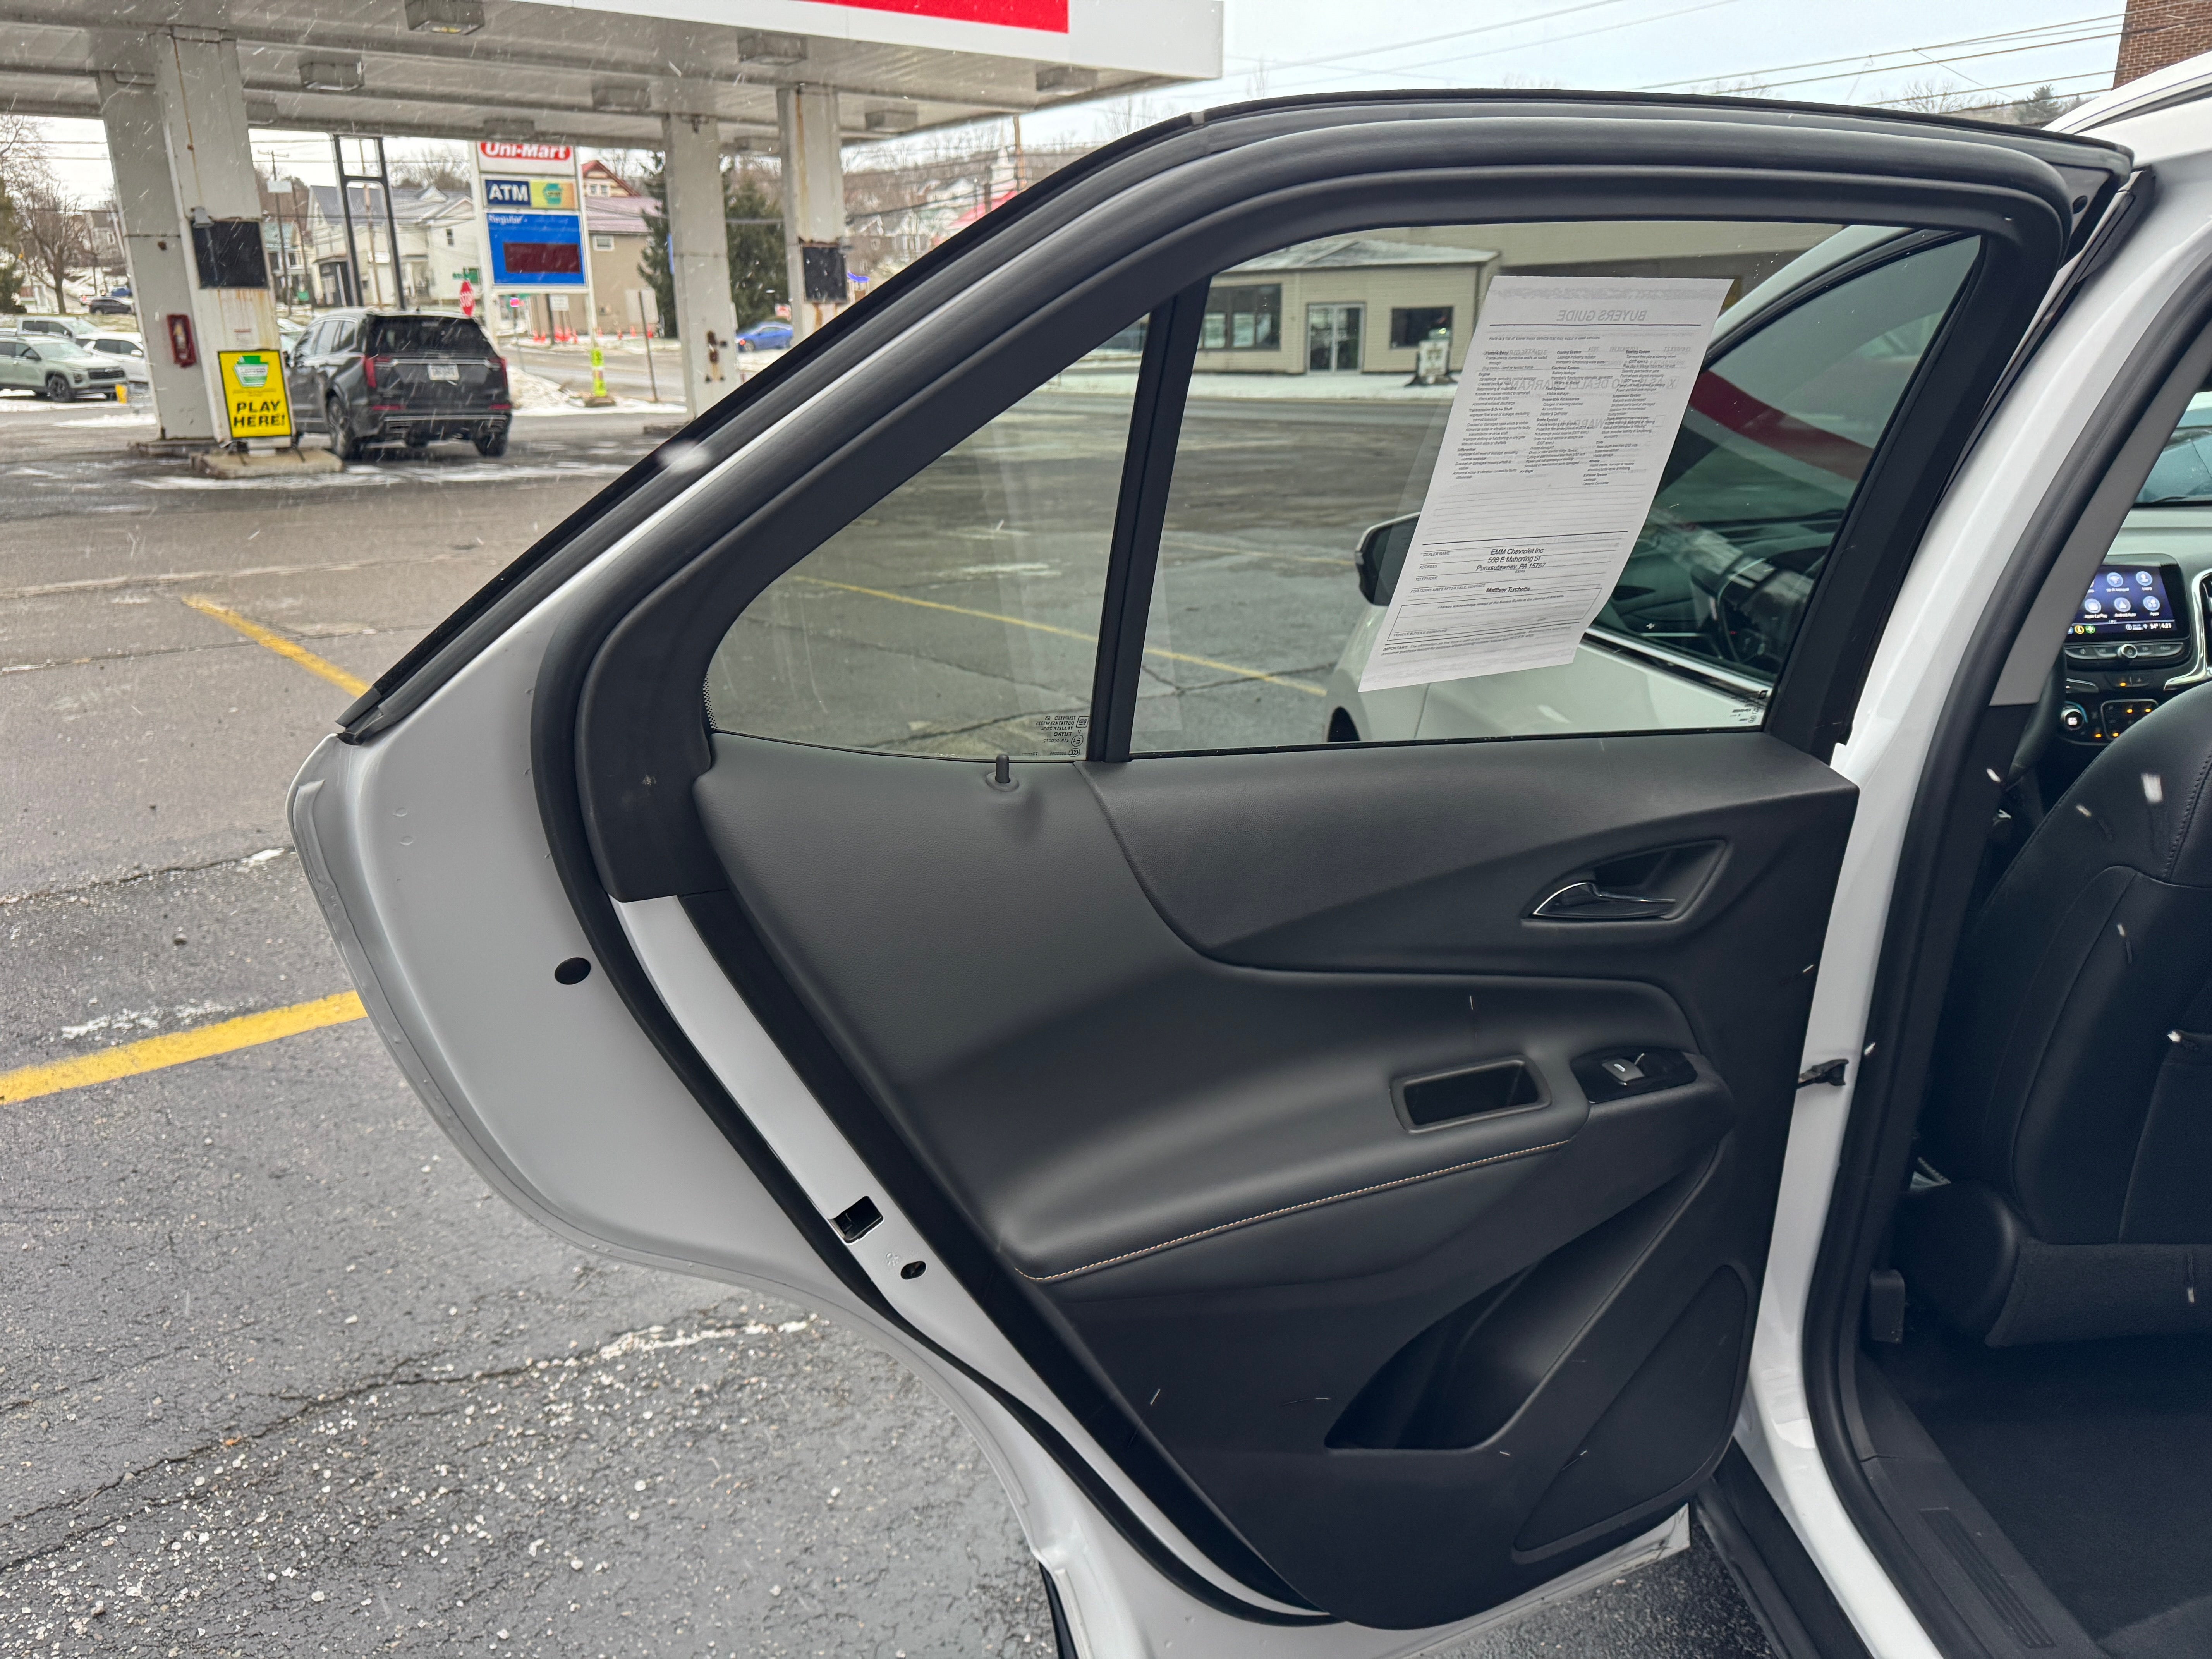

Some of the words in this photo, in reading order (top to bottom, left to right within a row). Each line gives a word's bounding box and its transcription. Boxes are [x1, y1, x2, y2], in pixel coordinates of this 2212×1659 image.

[484, 142, 566, 158] Uni-Mart
[489, 184, 528, 201] ATM
[237, 400, 280, 413] PLAY
[234, 414, 285, 428] HERE!
